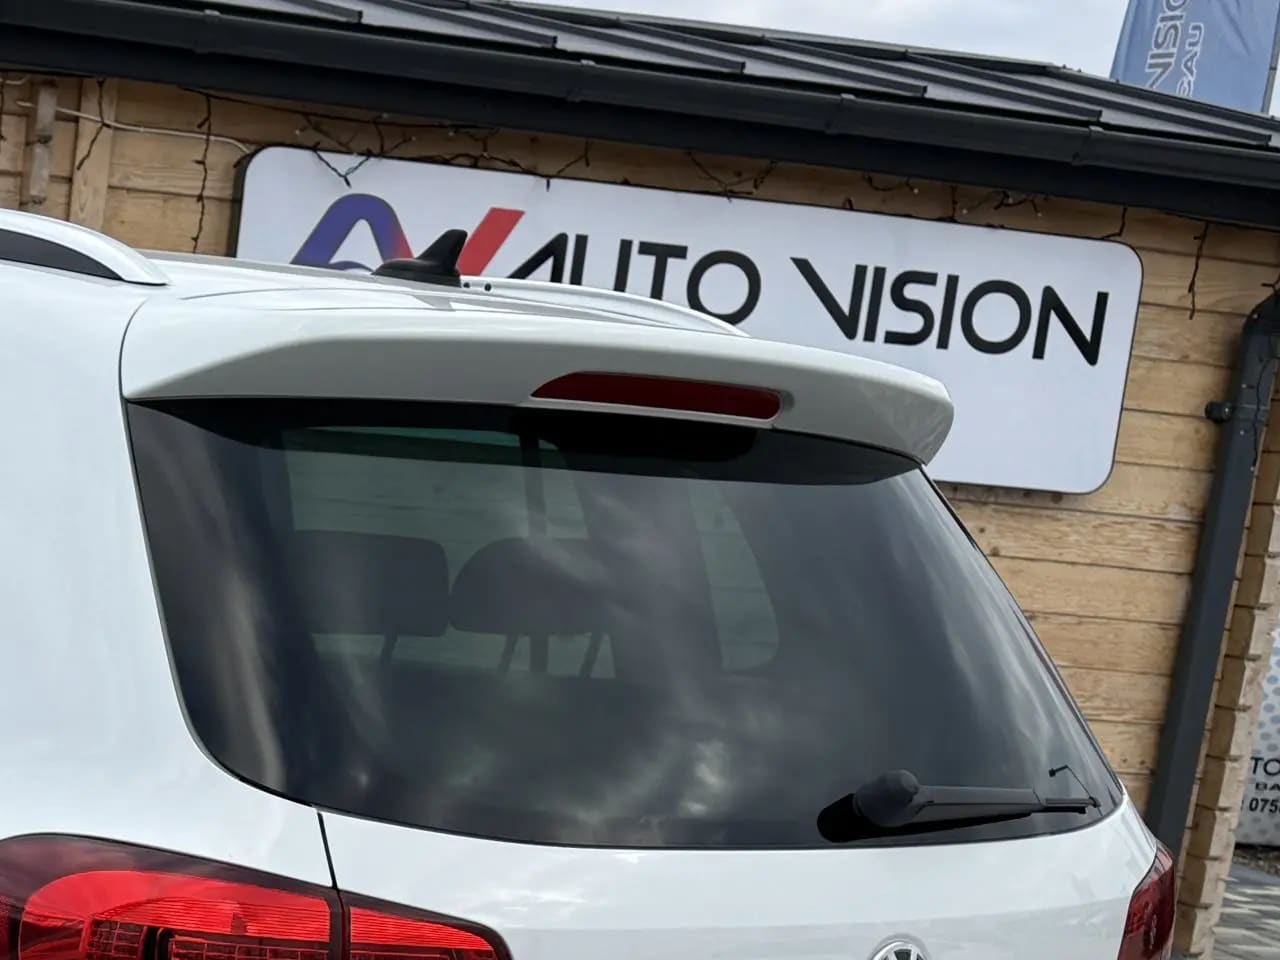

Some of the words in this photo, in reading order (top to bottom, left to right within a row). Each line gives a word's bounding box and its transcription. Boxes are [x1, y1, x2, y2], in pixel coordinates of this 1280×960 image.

[507, 232, 762, 326] AUTO
[790, 256, 1110, 367] VISION
[1249, 797, 1280, 813] 075
